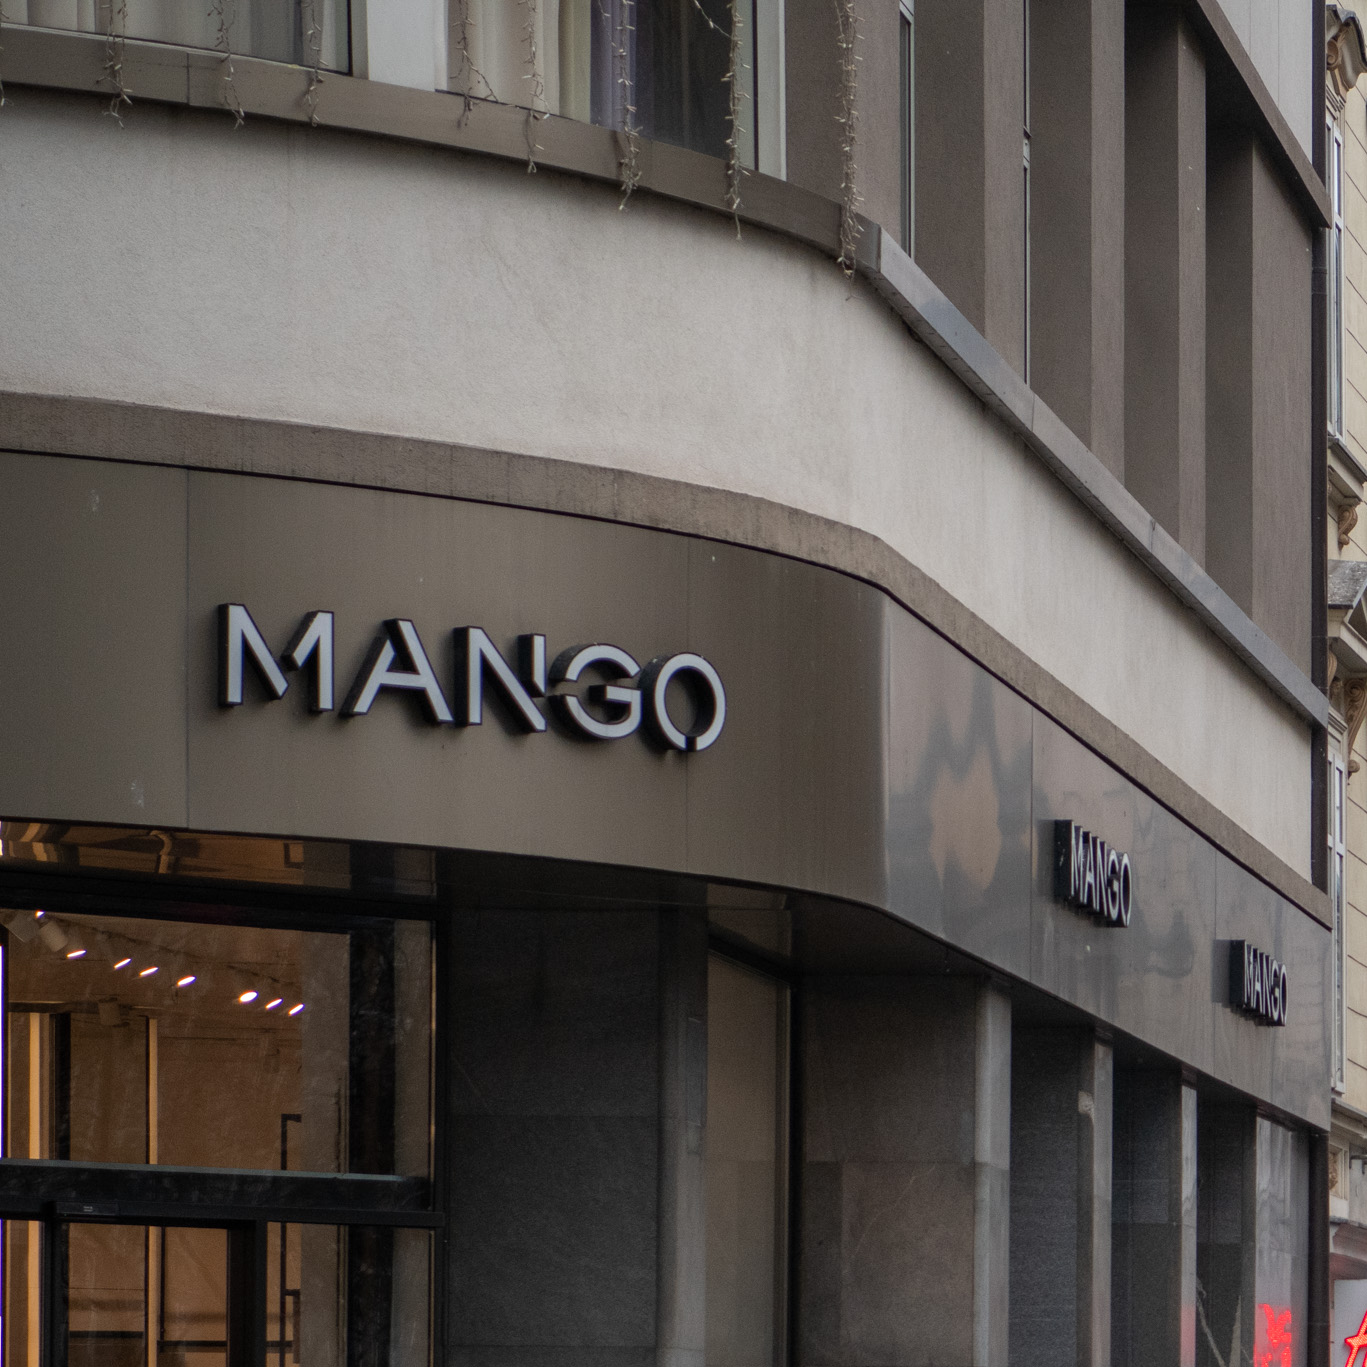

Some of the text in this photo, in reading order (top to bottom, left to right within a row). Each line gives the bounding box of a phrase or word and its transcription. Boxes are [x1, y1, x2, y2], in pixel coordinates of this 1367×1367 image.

[219, 603, 727, 752] MANGO
[1063, 820, 1133, 928] MANGO
[1237, 940, 1289, 1026] MANGO
